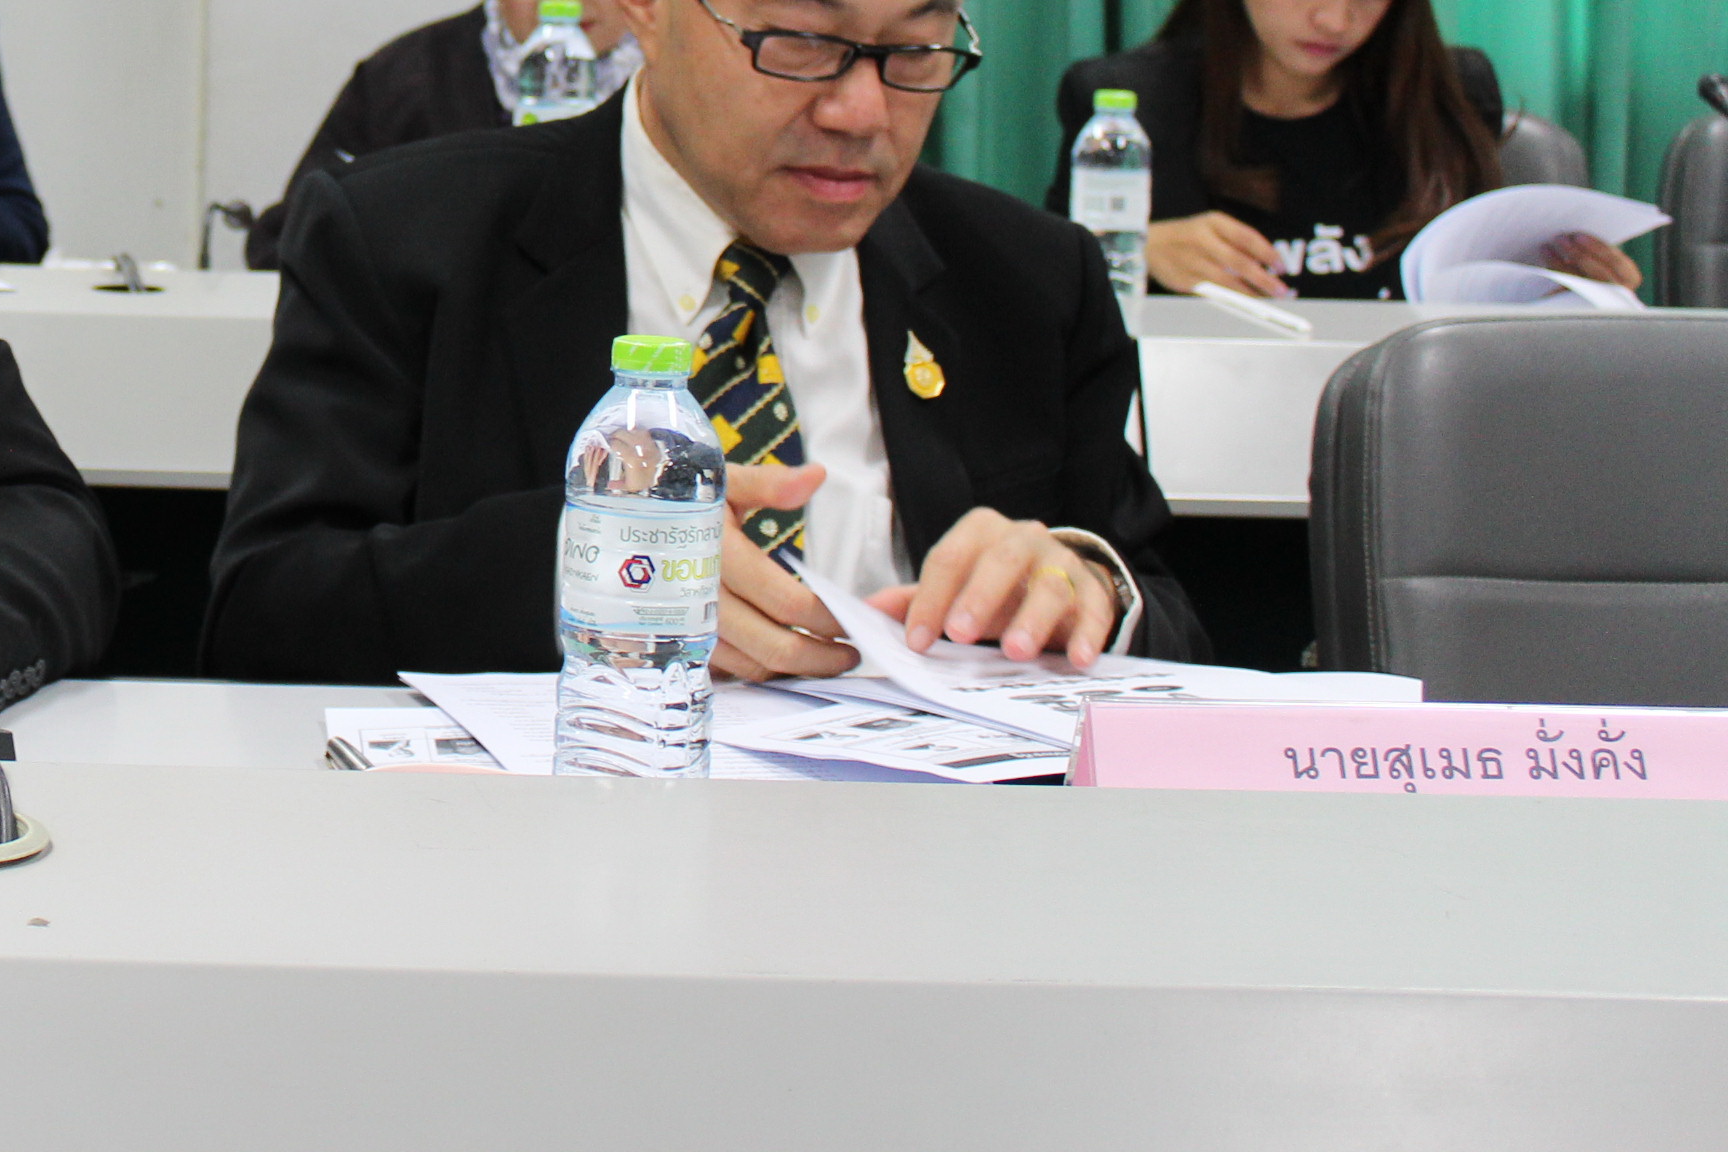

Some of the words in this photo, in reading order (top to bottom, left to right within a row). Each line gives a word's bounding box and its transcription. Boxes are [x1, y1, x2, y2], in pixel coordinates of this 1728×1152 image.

[1283, 743, 1504, 794] นายสุเมธ
[1524, 717, 1648, 780] มั่งคั่ง
